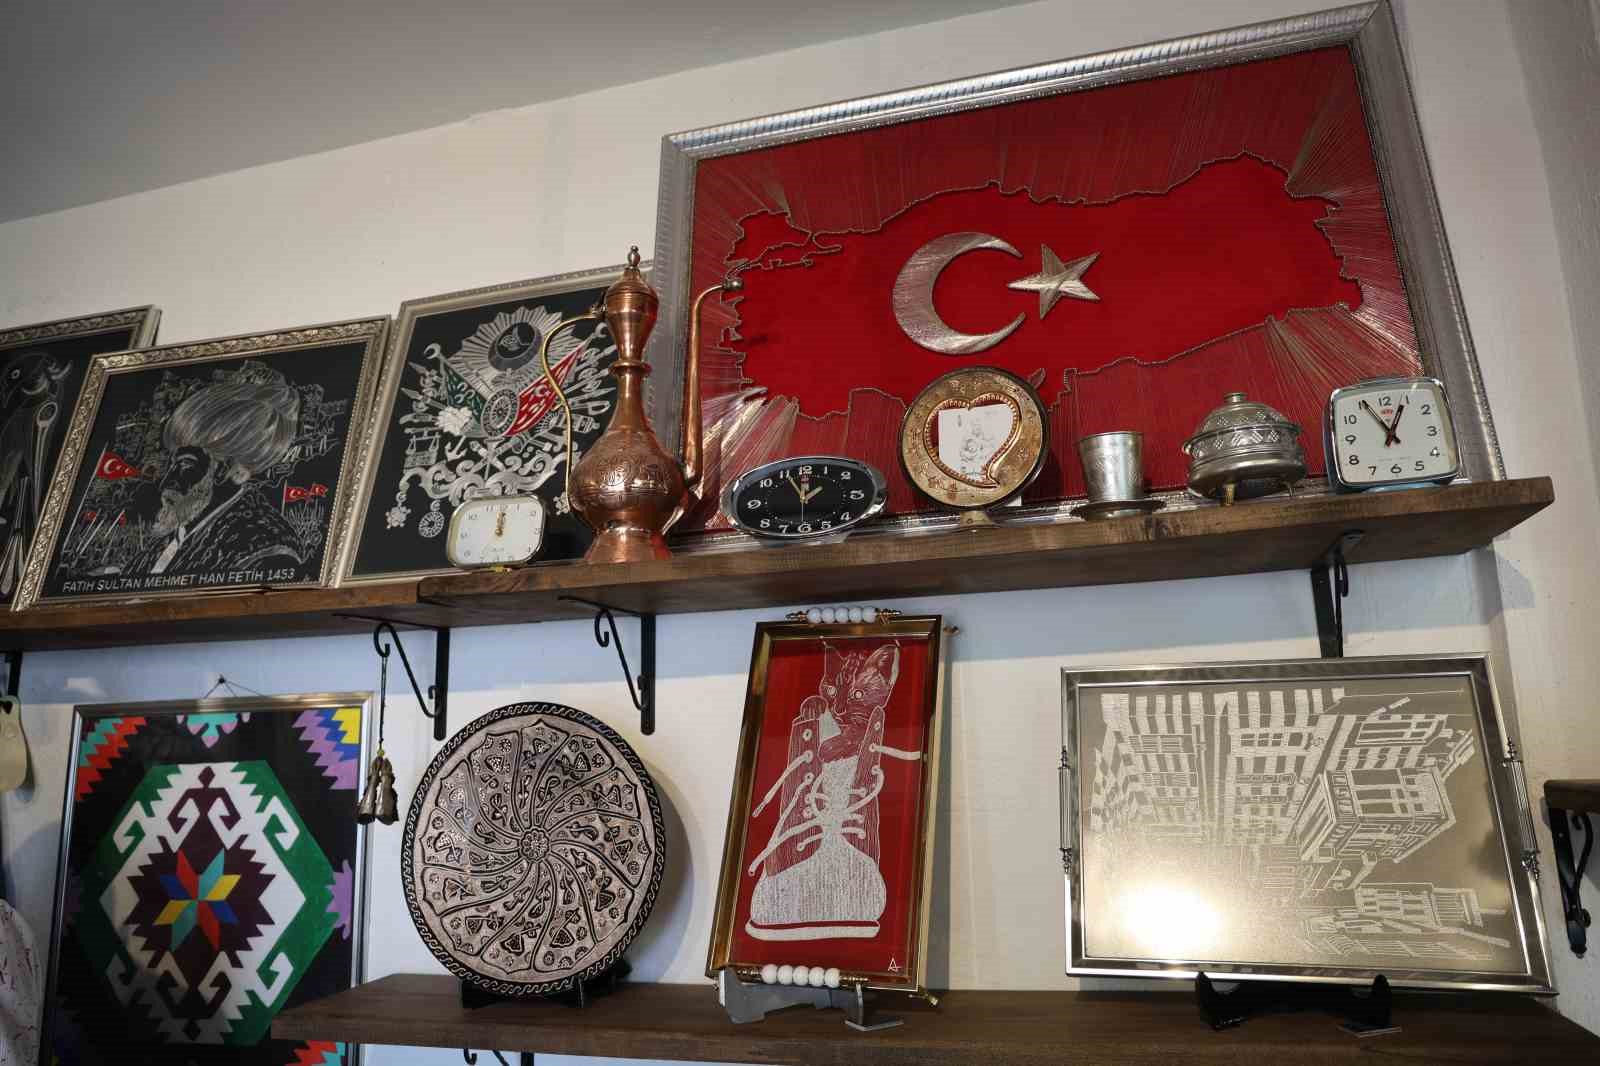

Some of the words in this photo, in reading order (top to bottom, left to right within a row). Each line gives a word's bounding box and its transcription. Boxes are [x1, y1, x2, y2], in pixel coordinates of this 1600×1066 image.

[1378, 396, 1392, 407] 12
[1405, 394, 1410, 405] 1
[1421, 404, 1431, 415] 2
[1344, 414, 1357, 425] 10
[1426, 426, 1438, 437] 3
[1345, 434, 1356, 445] 9
[1429, 446, 1441, 458] 4
[1348, 455, 1360, 465] 8
[798, 465, 813, 475] 12
[824, 466, 828, 475] 1
[1368, 466, 1377, 475] 7
[1390, 464, 1402, 474] 6
[1414, 461, 1425, 471] 5
[779, 469, 790, 480] 11
[840, 471, 851, 480] 2
[759, 478, 773, 488] 10
[850, 489, 865, 500] 3
[747, 499, 761, 510] 9
[840, 511, 851, 521] 4
[759, 519, 770, 528] 8
[797, 523, 812, 533] 6
[821, 520, 831, 530] 5
[778, 524, 789, 534] 7
[97, 579, 141, 591] SULTAN
[144, 575, 197, 588] MEHMET
[199, 572, 225, 584] HAN
[267, 568, 296, 580] 1453
